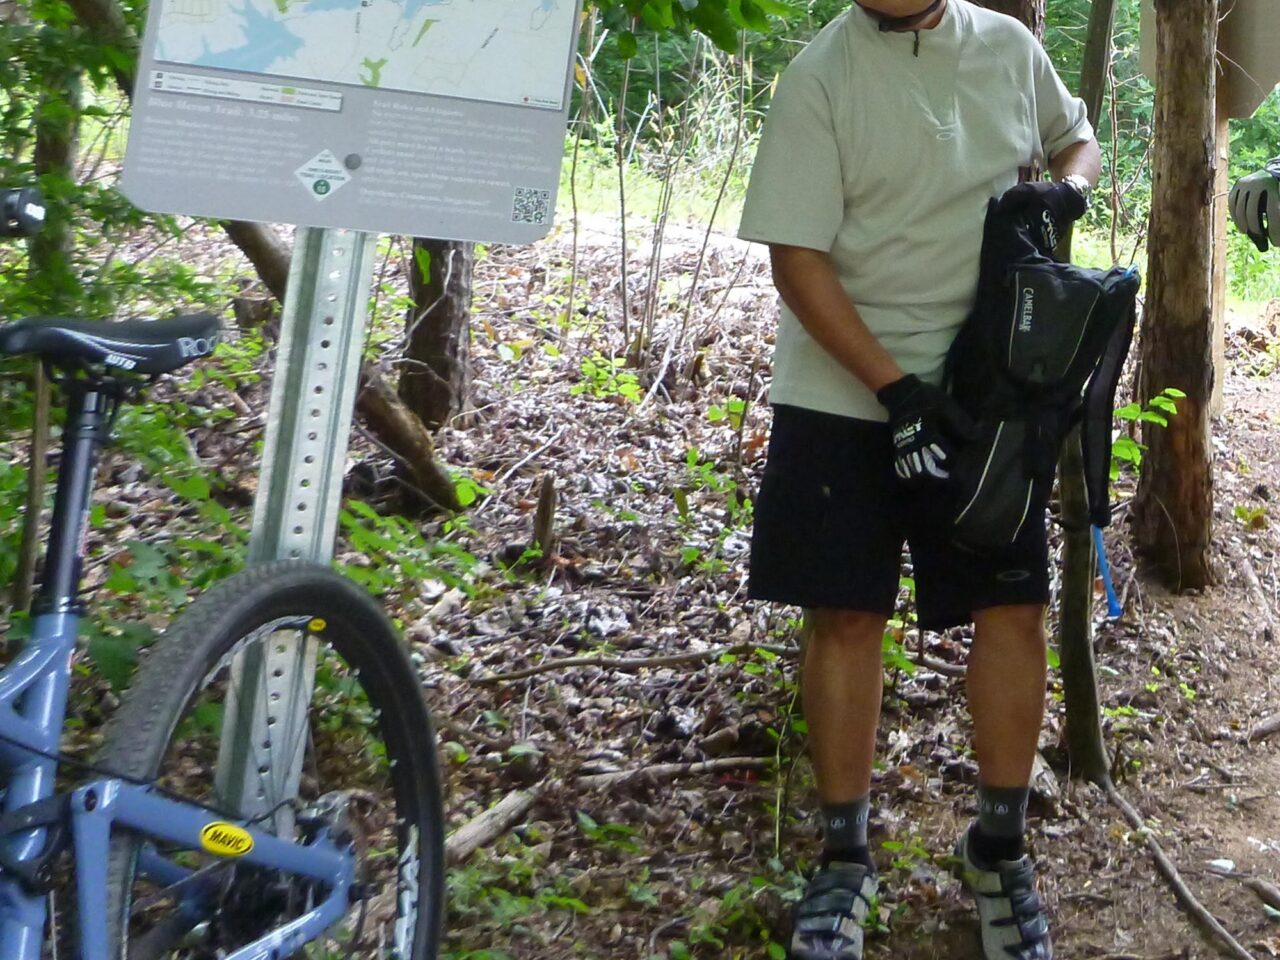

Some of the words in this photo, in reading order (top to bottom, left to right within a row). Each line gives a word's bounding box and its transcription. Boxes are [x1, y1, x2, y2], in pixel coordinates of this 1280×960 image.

[1022, 287, 1034, 332] CAMELBAK
[105, 354, 137, 370] WTB
[208, 829, 246, 851] MAVIC
